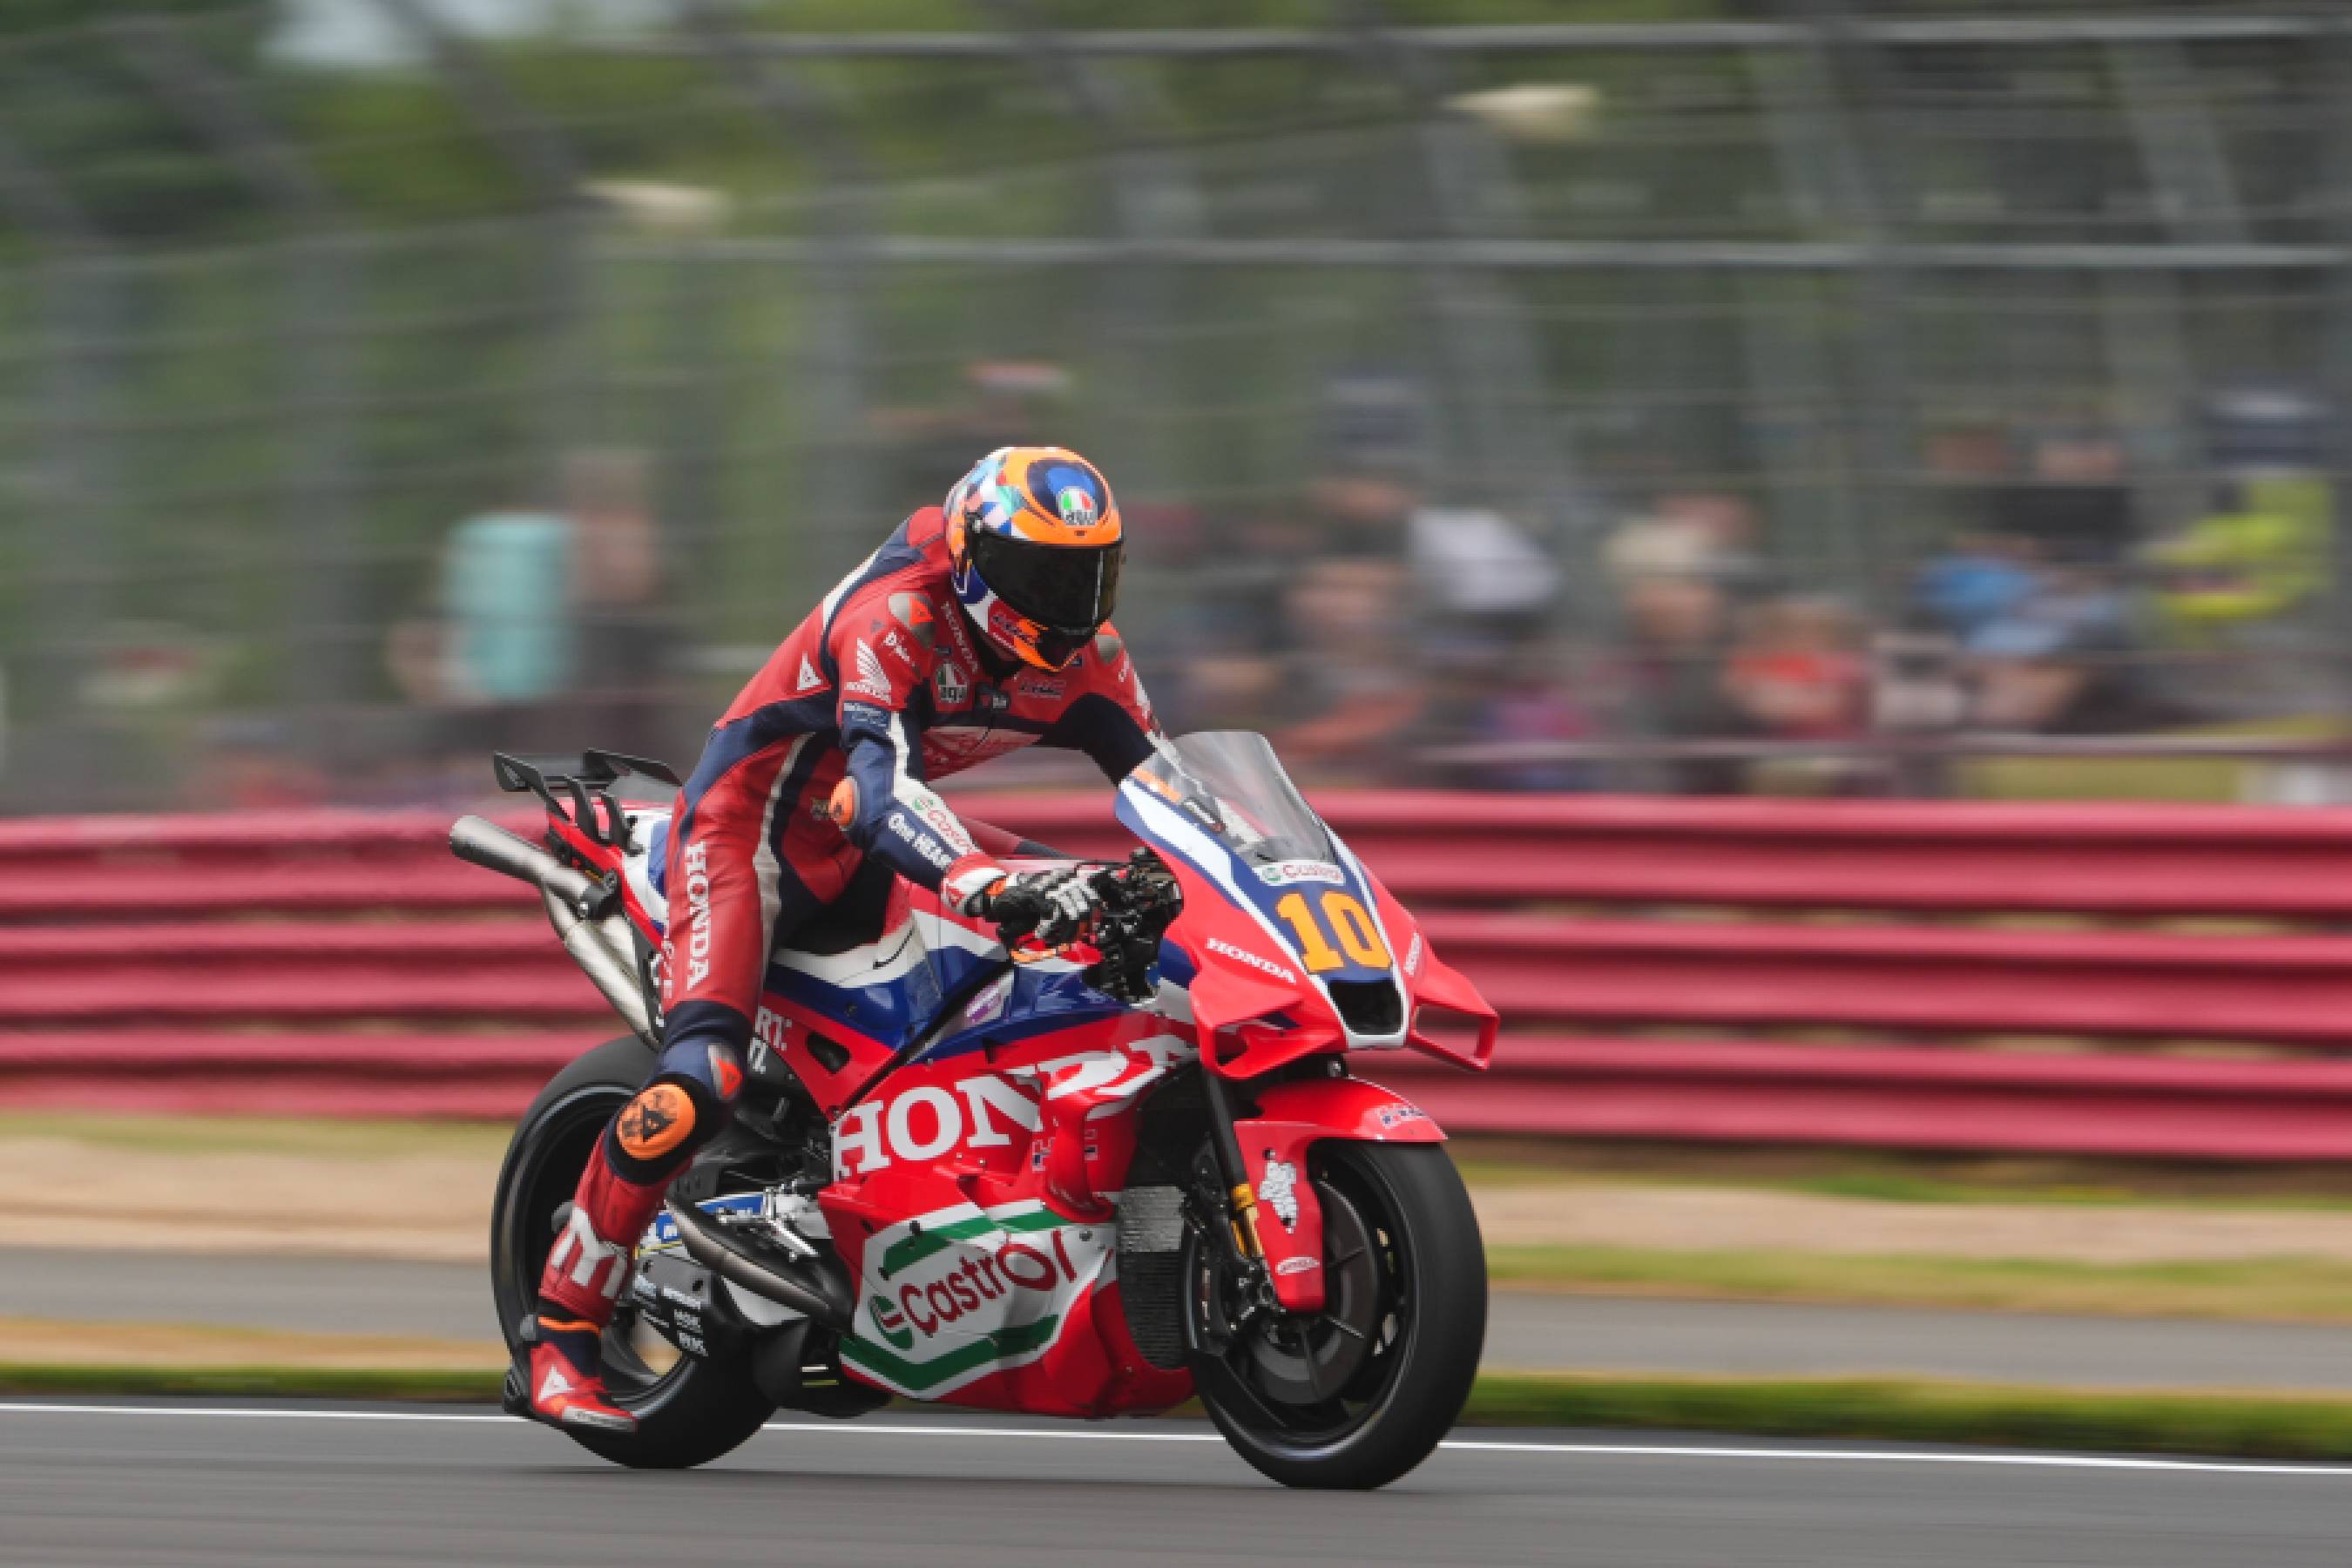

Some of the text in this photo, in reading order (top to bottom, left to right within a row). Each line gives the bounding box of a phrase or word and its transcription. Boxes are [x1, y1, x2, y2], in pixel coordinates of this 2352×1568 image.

[888, 812, 916, 842] One
[685, 841, 711, 991] HONDA
[1274, 890, 1392, 974] 10
[1206, 937, 1296, 984] HONDA
[900, 1229, 1078, 1335] Castrol
